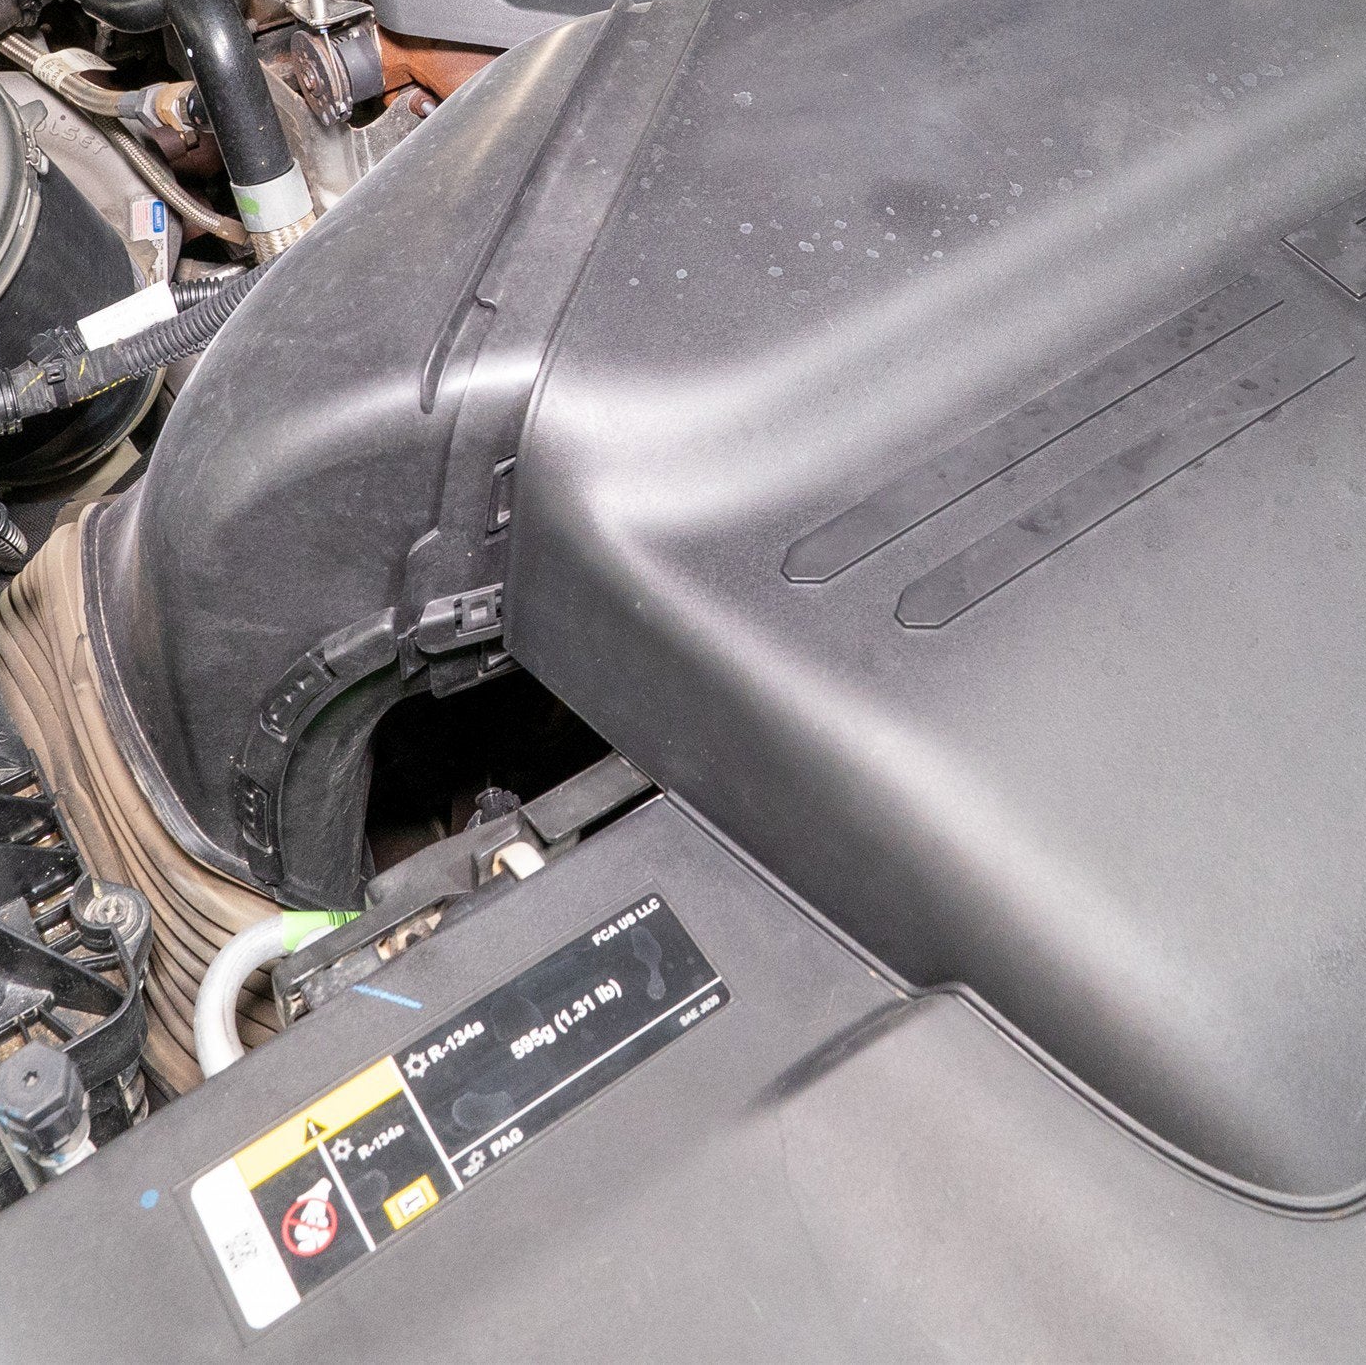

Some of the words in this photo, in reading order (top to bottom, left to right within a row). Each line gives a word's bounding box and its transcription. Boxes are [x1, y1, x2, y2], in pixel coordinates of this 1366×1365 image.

[592, 924, 619, 946] FCA
[617, 912, 636, 930] US
[635, 897, 661, 919] LLC
[510, 1024, 556, 1059] 595g
[554, 994, 596, 1034] (1.31
[594, 978, 623, 1004] lb)
[679, 1007, 701, 1027] SAE
[427, 1021, 485, 1063] R-134a
[357, 1124, 405, 1161] R-134a
[489, 1127, 524, 1157] PAG
